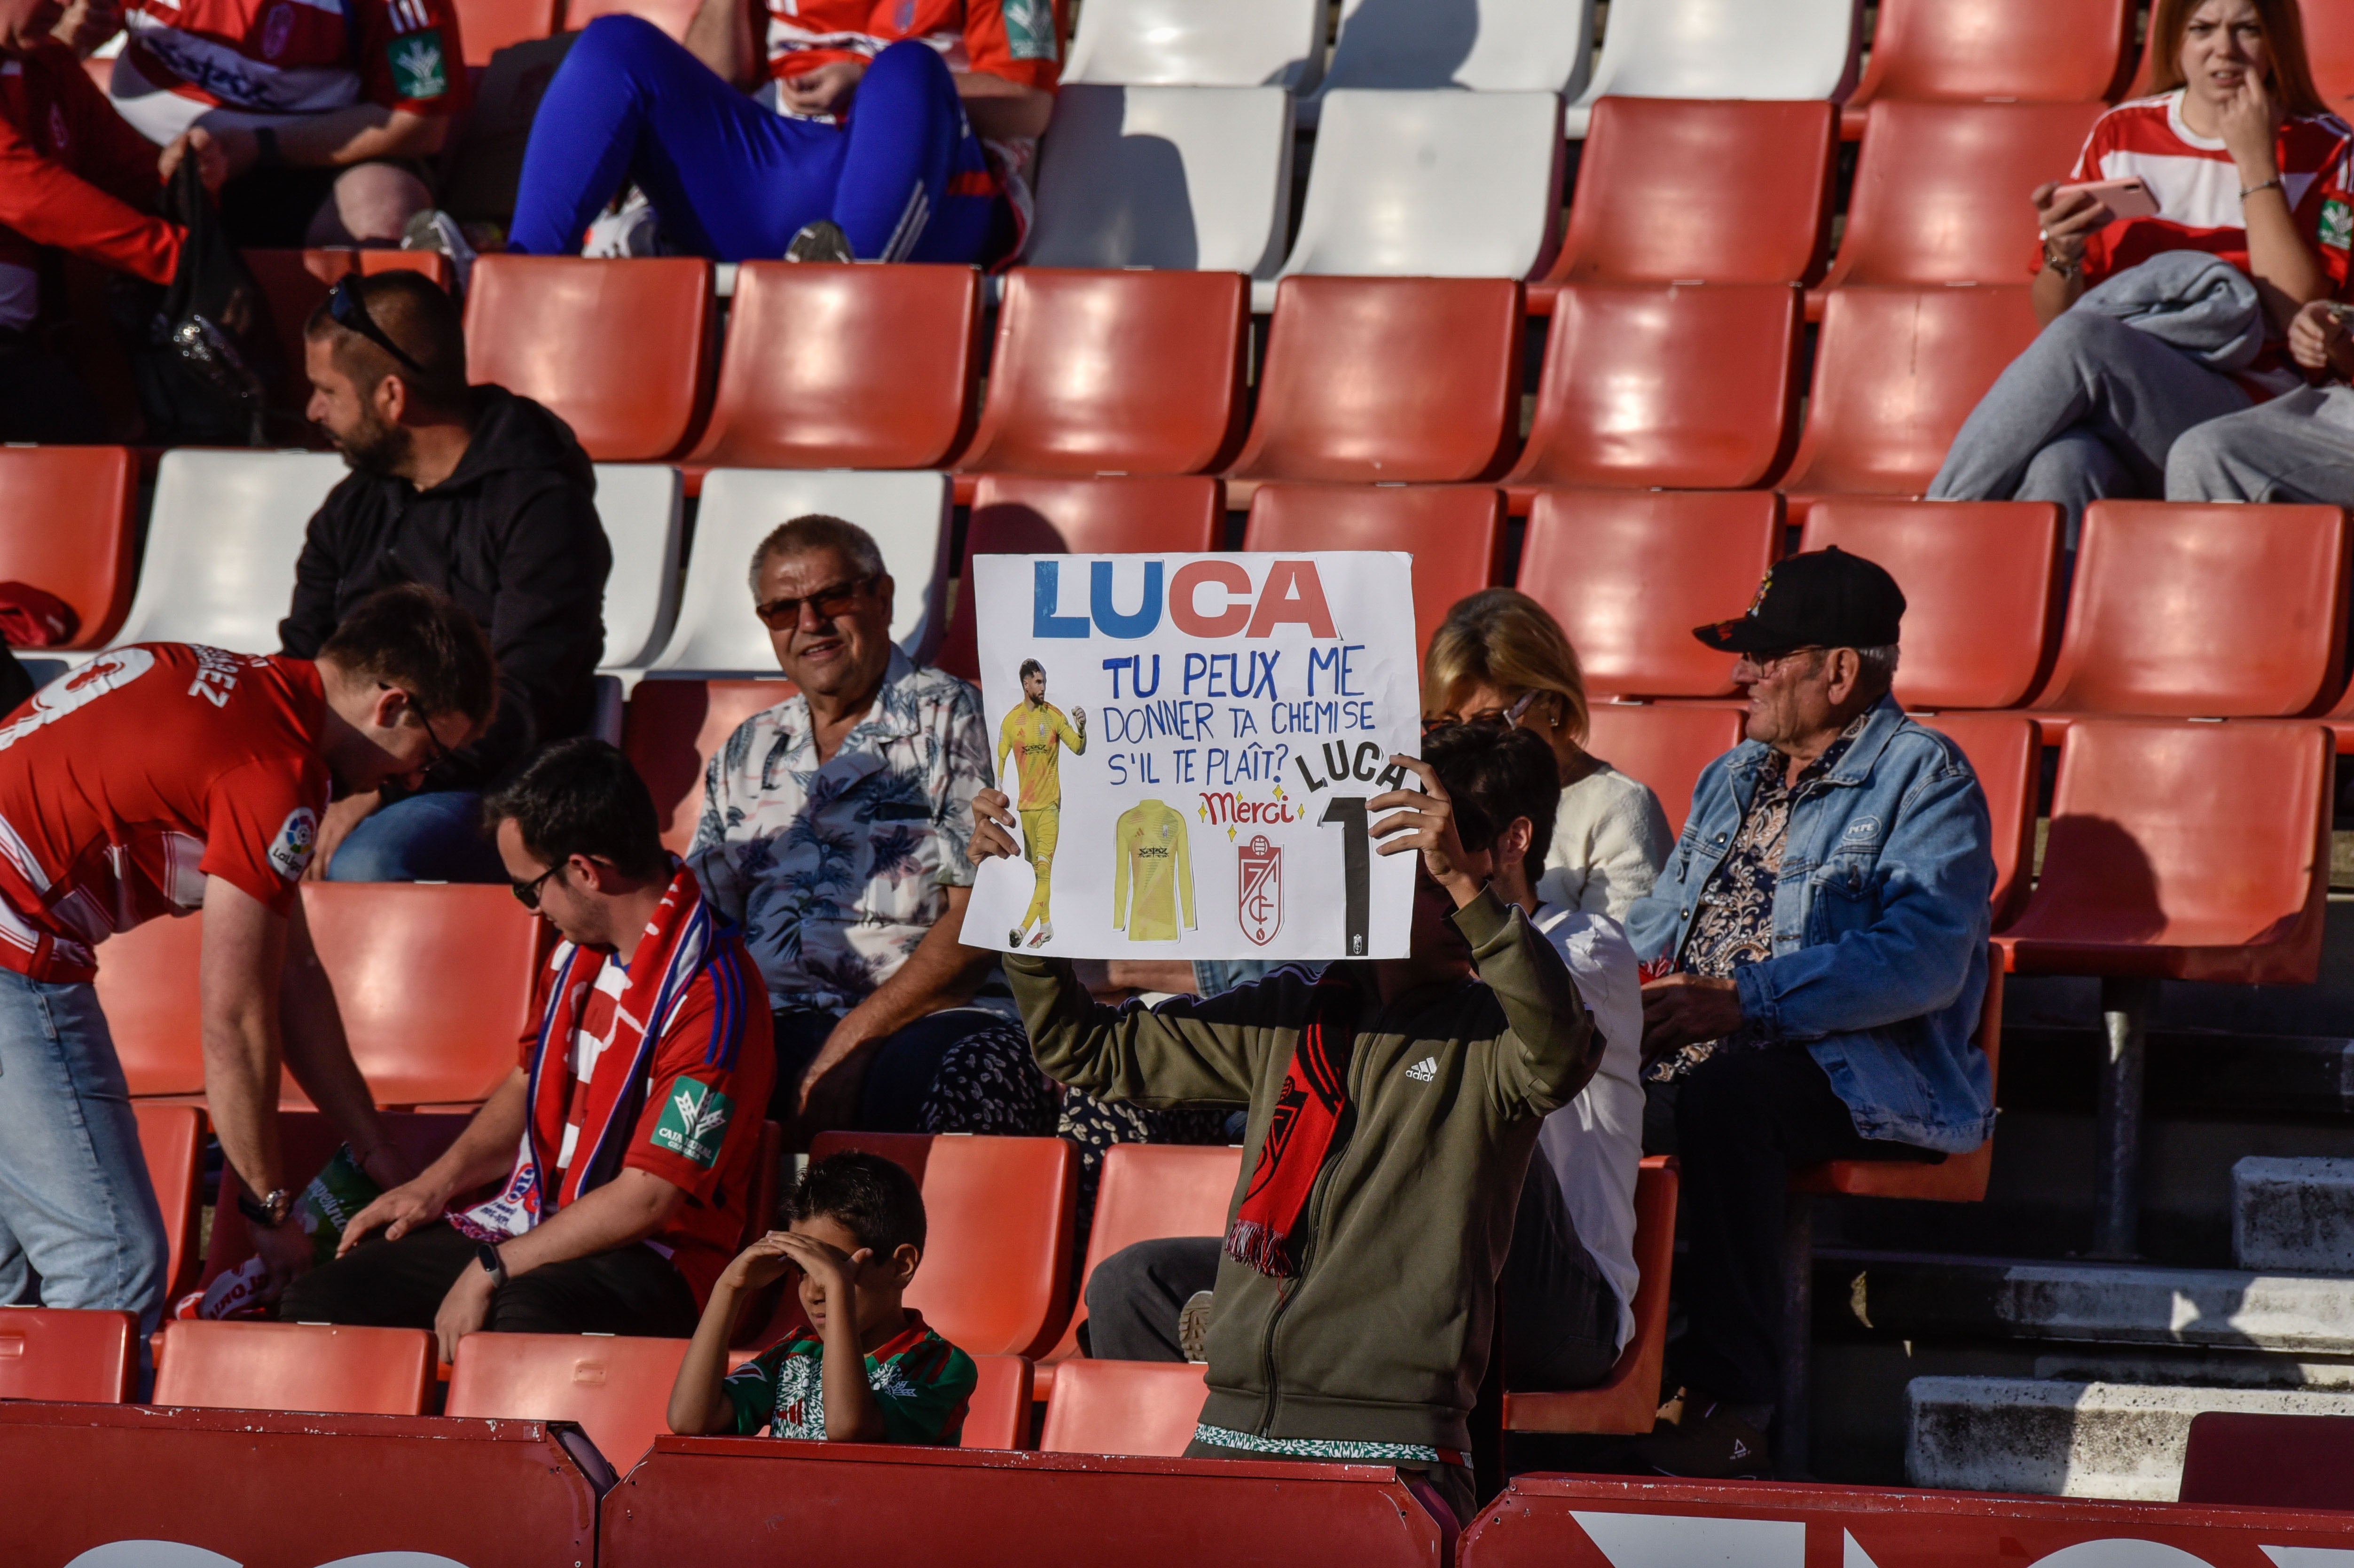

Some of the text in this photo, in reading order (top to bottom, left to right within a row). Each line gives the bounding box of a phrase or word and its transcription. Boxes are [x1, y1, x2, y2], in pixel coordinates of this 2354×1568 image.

[1033, 560, 1337, 639] LUCA
[1103, 645, 1365, 702] TU PEUX ME
[1103, 700, 1375, 744] DONNER TA CHEMISE
[1108, 742, 1289, 785] S'IL TE PLAÎT?
[1295, 739, 1409, 793] LUCA
[1199, 792, 1294, 825] Merci
[1322, 797, 1370, 956] 1
[1405, 1069, 1434, 1082] adid
